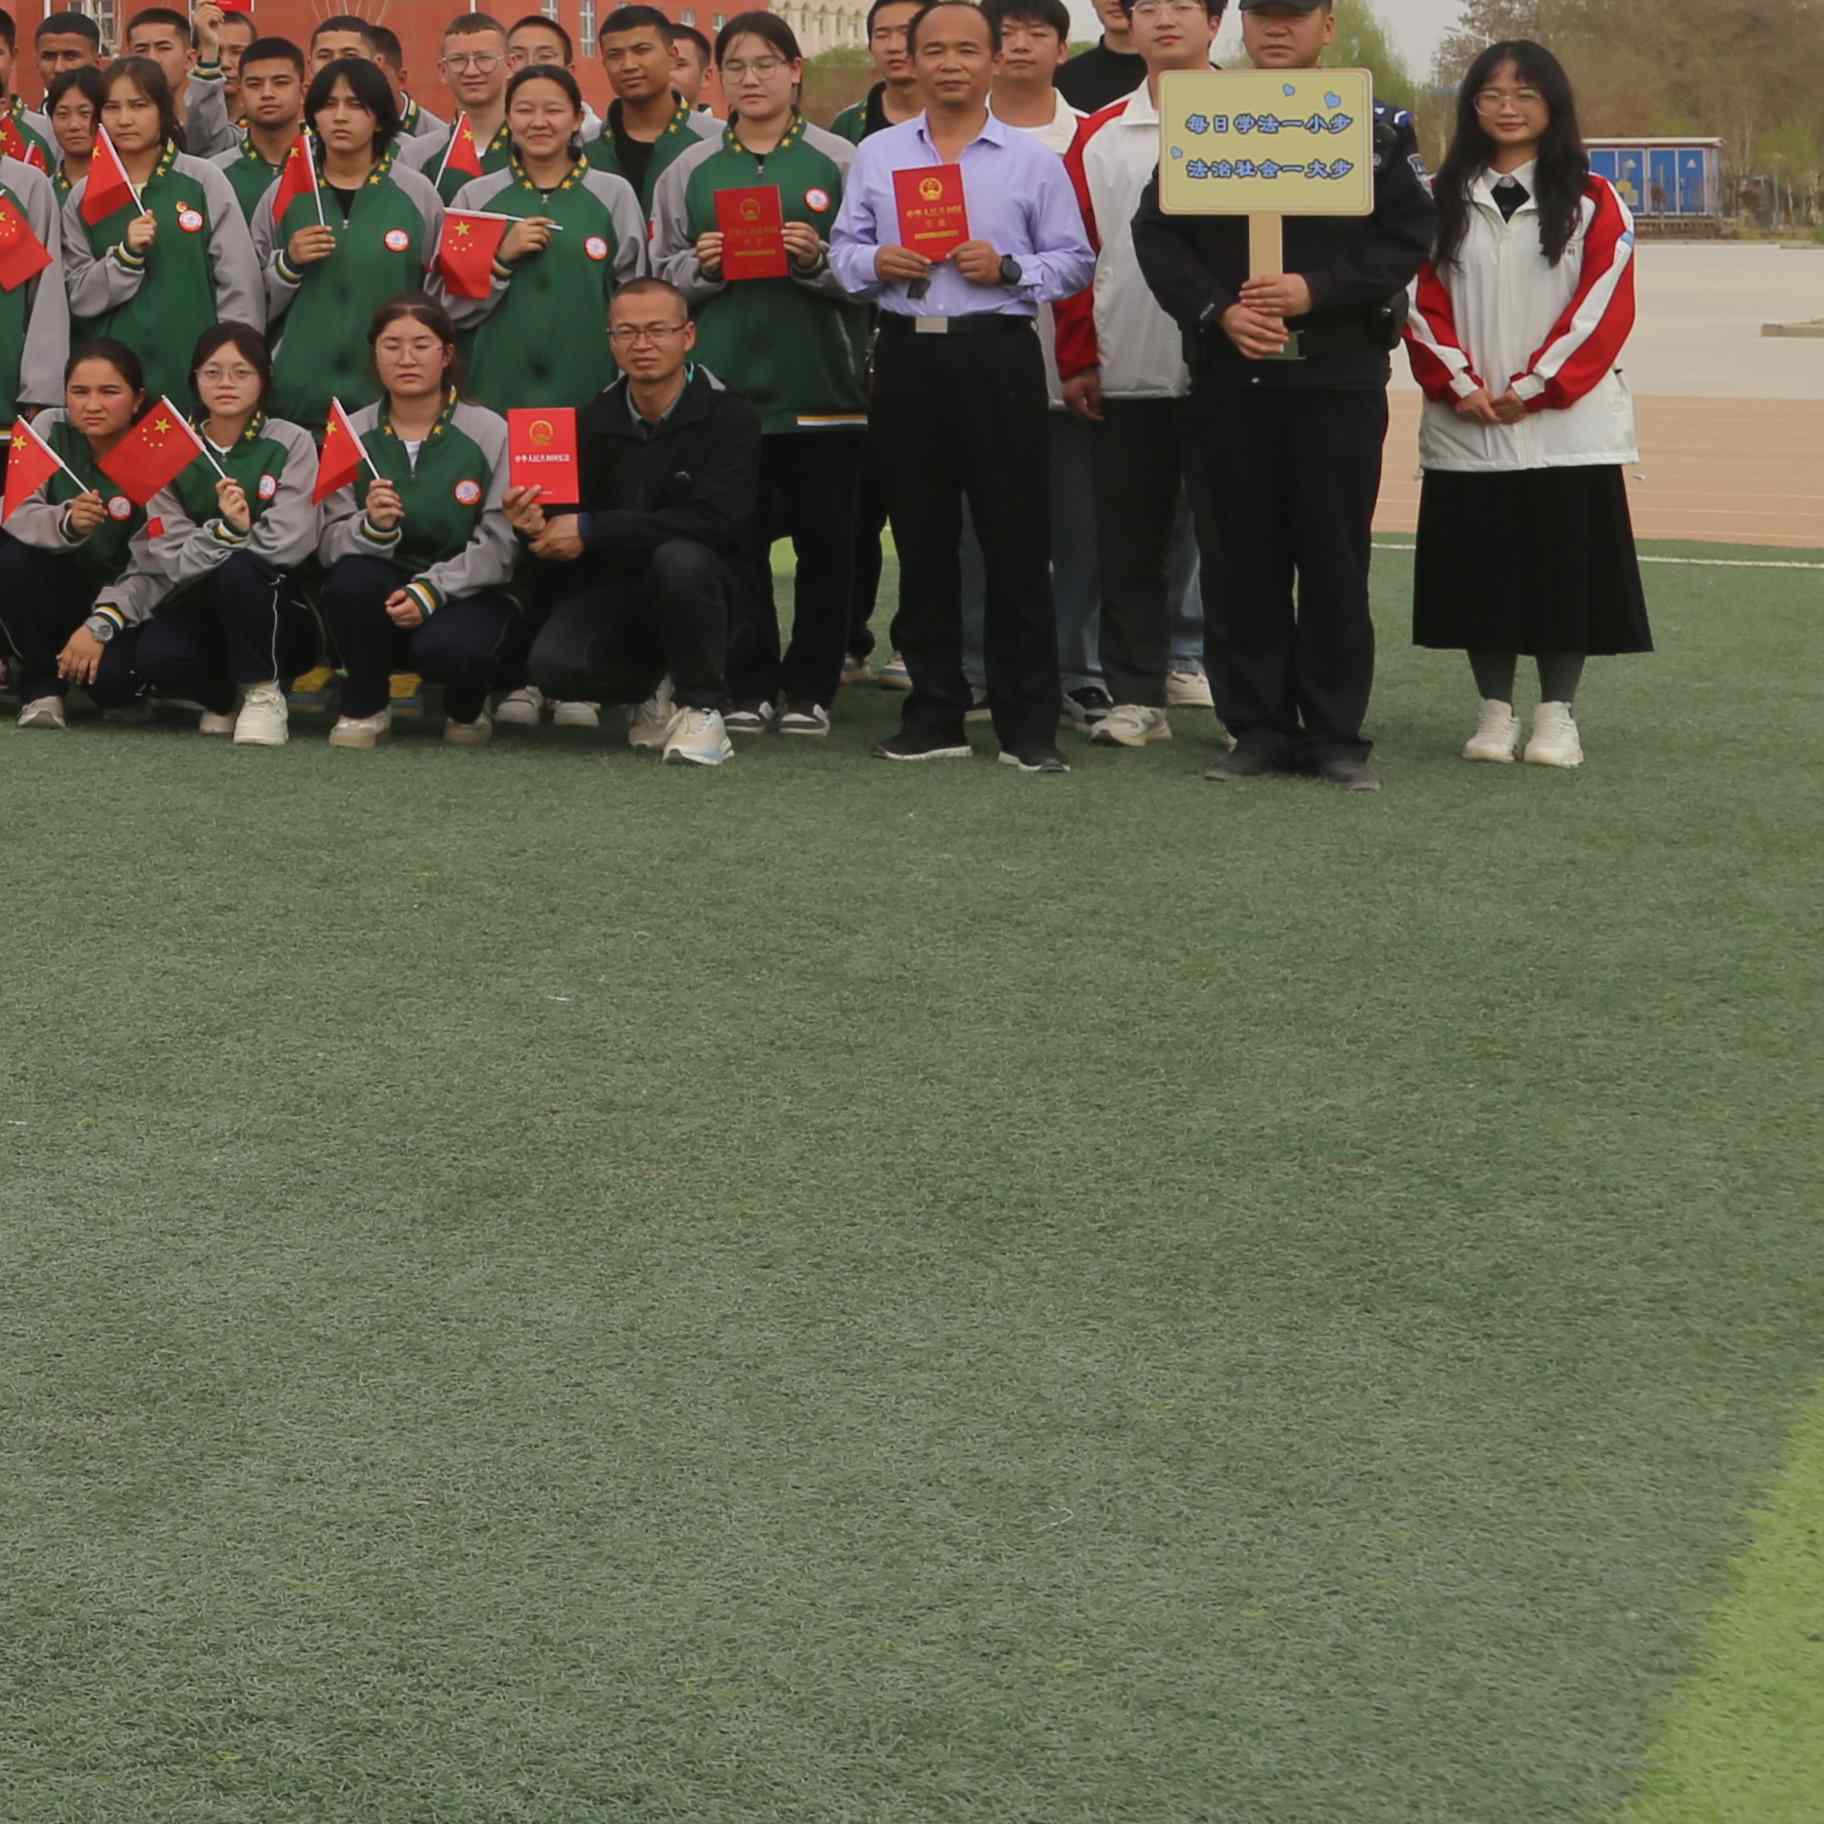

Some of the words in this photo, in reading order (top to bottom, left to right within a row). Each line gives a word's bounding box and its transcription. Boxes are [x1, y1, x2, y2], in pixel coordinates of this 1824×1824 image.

[1185, 113, 1353, 135] 每日学法一小步
[1185, 158, 1354, 179] 法治社会一大步
